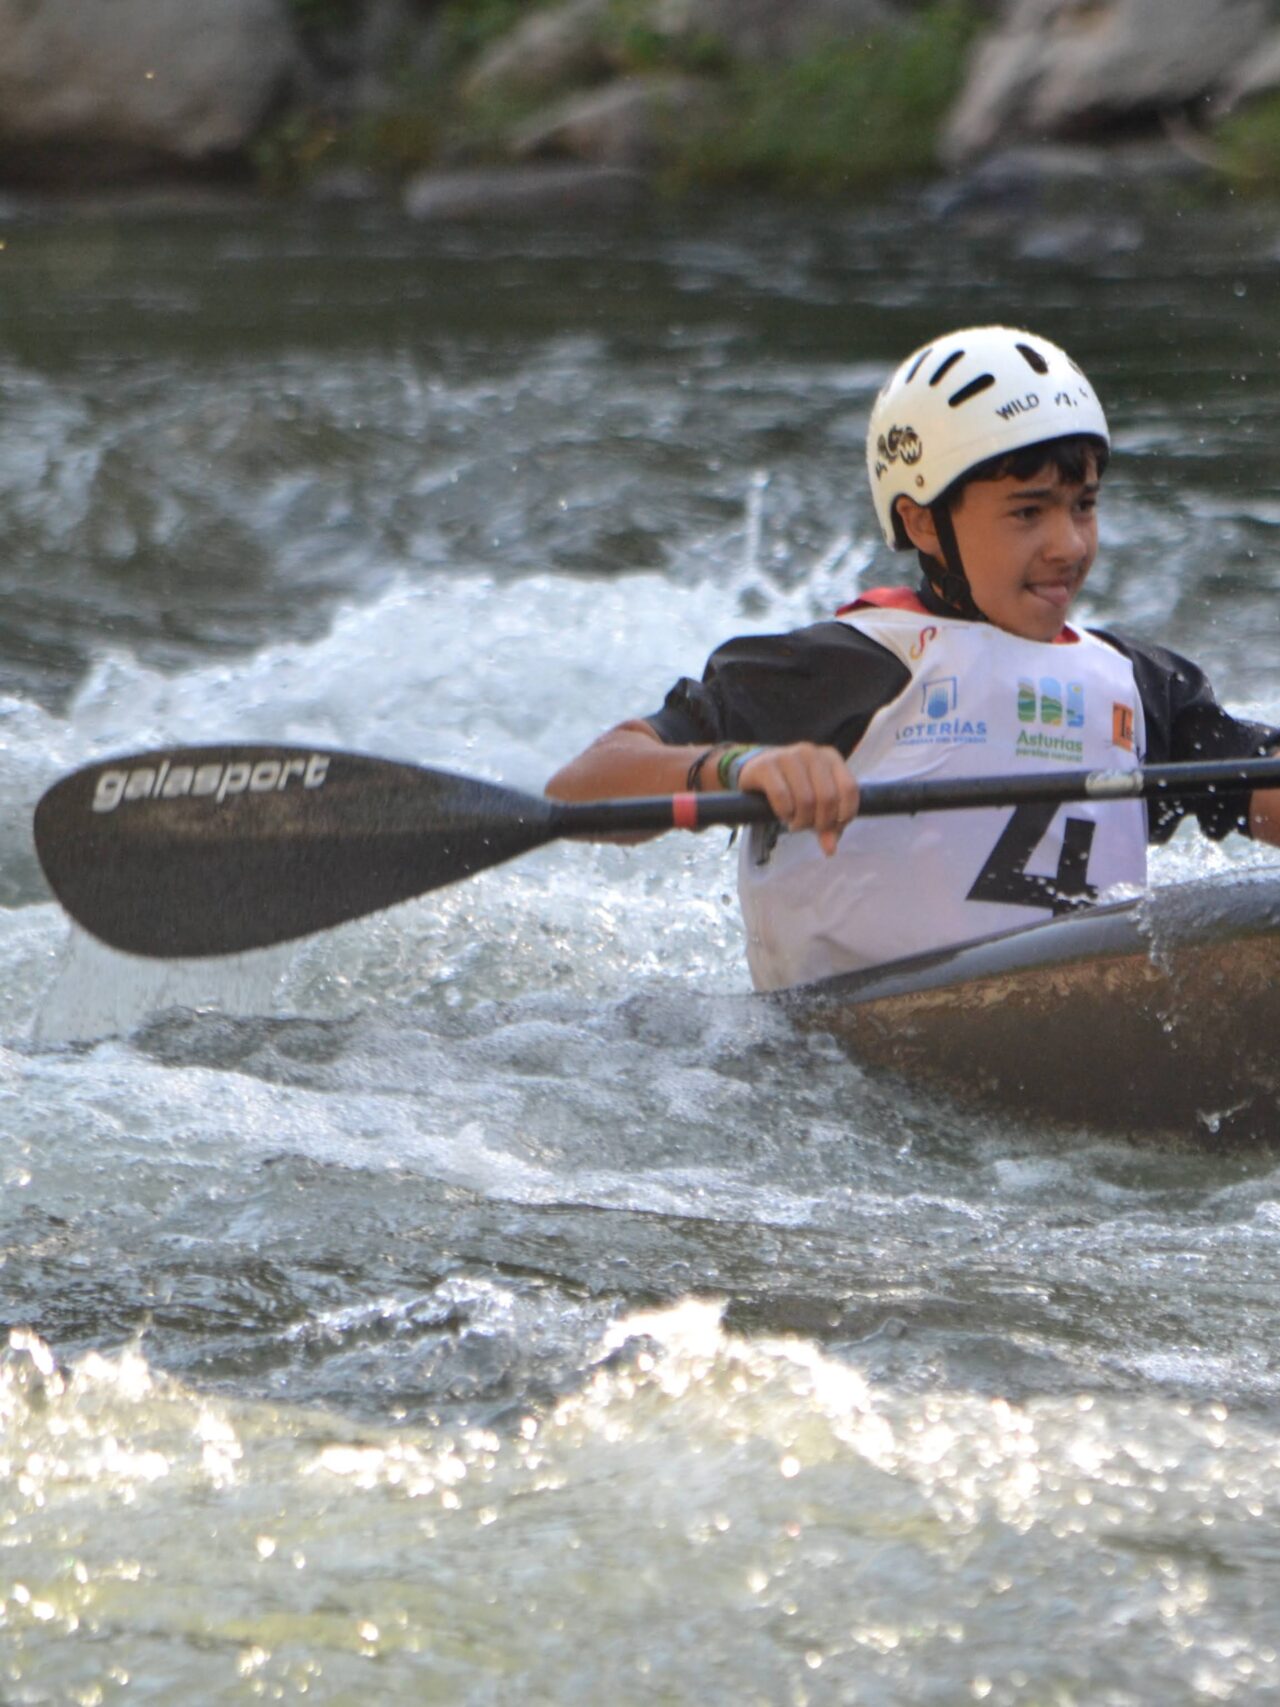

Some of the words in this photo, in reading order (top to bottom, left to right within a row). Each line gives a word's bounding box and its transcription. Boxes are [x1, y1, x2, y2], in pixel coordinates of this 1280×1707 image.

[995, 392, 1040, 421] WILD
[1016, 730, 1084, 752] Asturias
[91, 753, 331, 813] galasport
[965, 803, 1098, 917] 4
